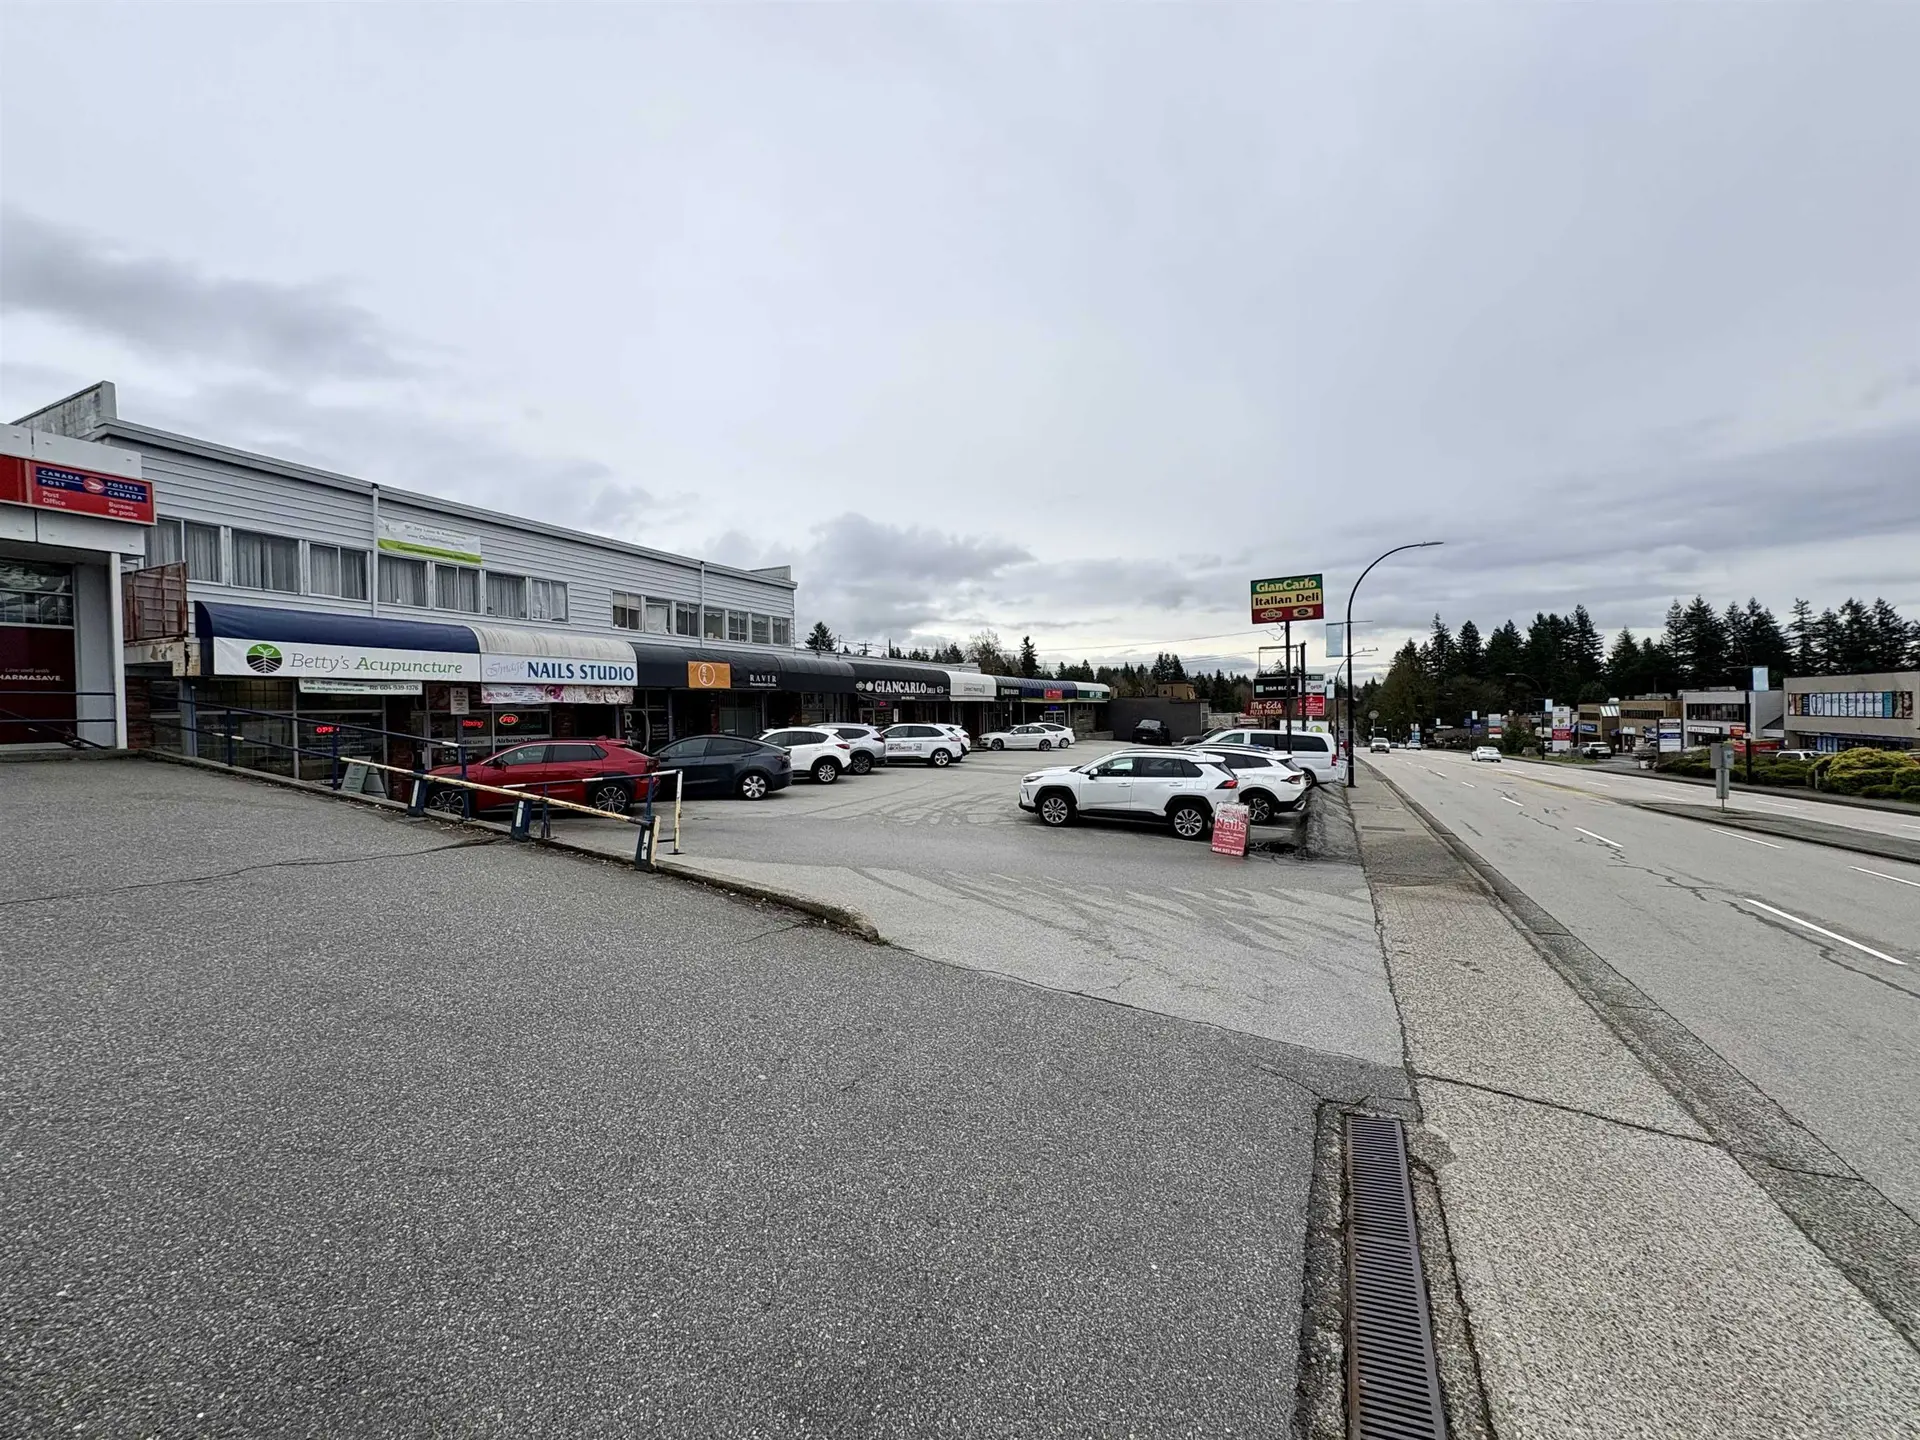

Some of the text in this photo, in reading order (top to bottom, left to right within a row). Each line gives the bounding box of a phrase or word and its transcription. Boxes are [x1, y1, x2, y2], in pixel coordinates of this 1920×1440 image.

[41, 470, 80, 480] CANADA
[42, 479, 66, 487] POST
[107, 482, 139, 492] POSTES
[42, 490, 59, 498] Post
[108, 490, 143, 500] CANADA
[43, 497, 66, 506] Office
[119, 510, 139, 518] poste
[1256, 577, 1317, 593] GianCarlo
[1255, 592, 1319, 606] Italian Deli
[289, 653, 463, 675] Betty's Acupuncture
[527, 662, 575, 679] NAILS
[580, 664, 635, 681] STUDIO
[750, 674, 777, 683] RAVIR
[874, 680, 927, 694] GIANCARLO
[1215, 818, 1246, 831] Nails
